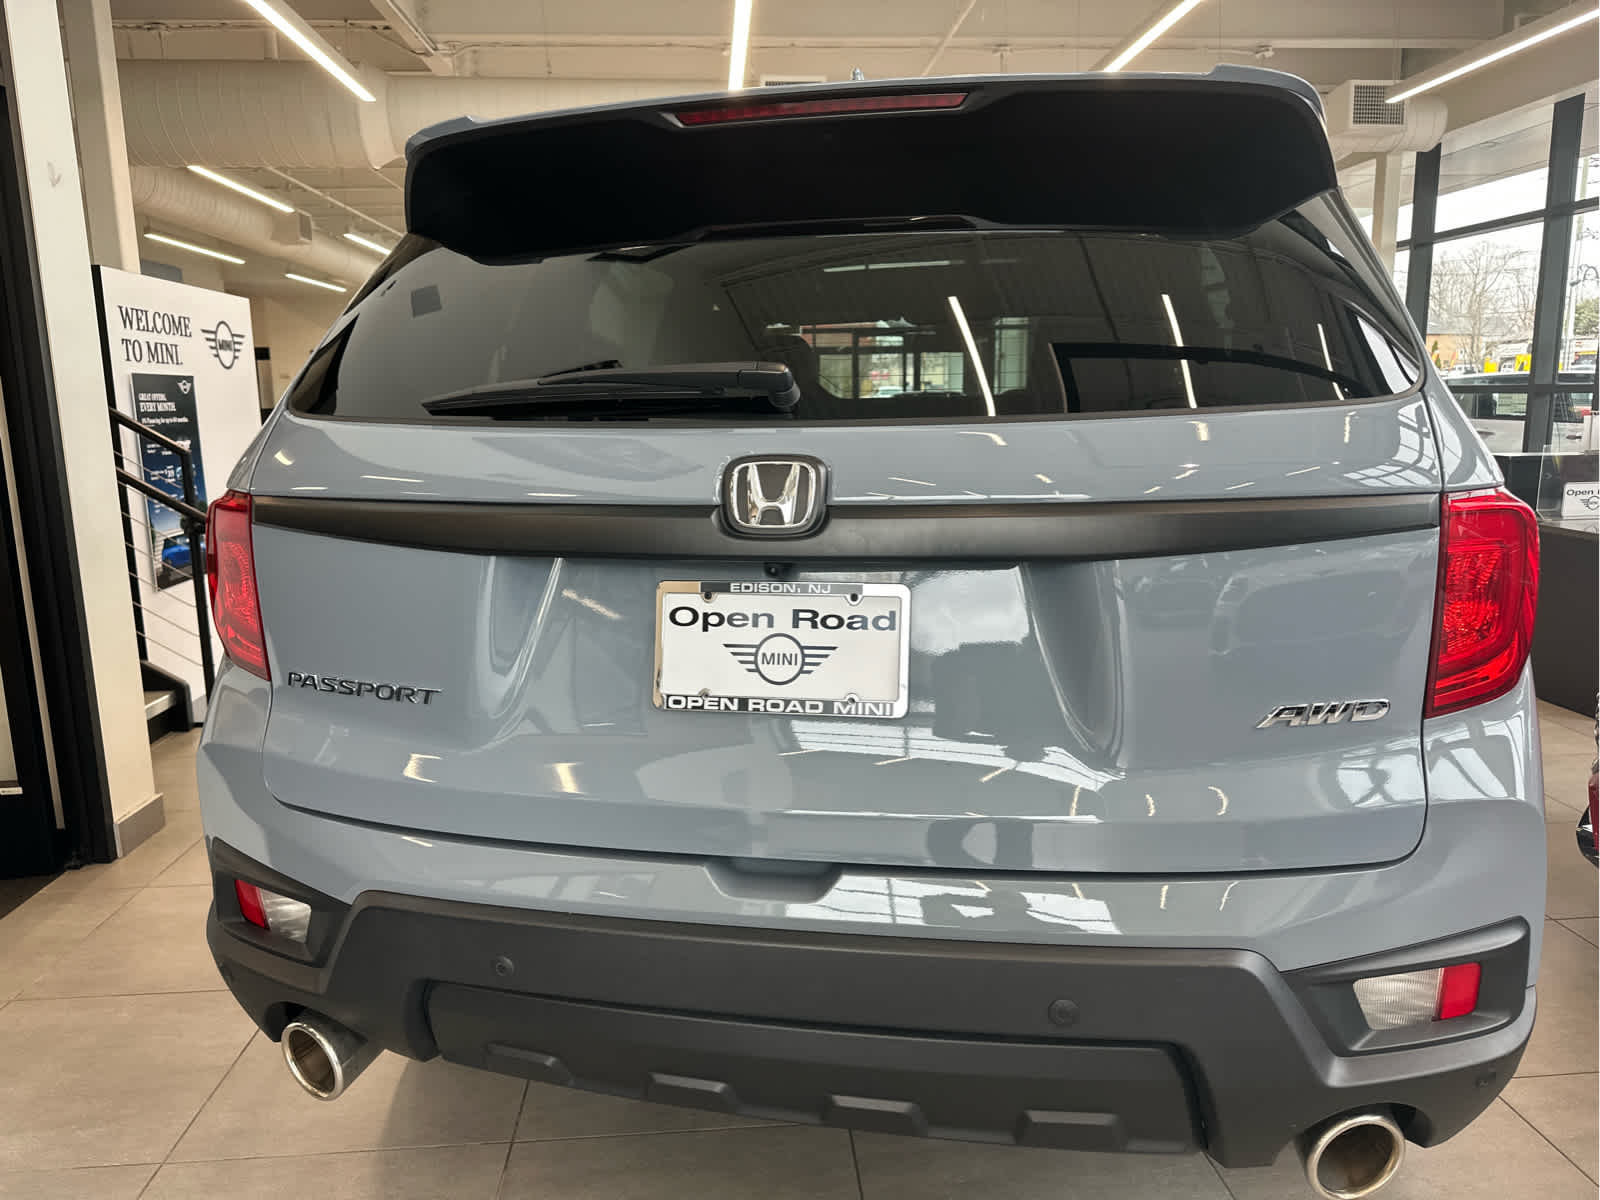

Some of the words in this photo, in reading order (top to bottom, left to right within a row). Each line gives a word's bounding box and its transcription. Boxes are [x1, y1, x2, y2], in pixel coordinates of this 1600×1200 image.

[118, 305, 192, 338] WELCOME
[121, 338, 142, 363] TO
[147, 341, 183, 366] MINI.
[1566, 489, 1593, 497] Open
[808, 583, 831, 594] NJ
[669, 606, 774, 632] Open
[792, 608, 896, 631] Road
[761, 652, 798, 666] MINI
[287, 671, 442, 704] PASSPORT
[667, 696, 739, 711] OPEN
[748, 698, 823, 714] ROAD
[833, 701, 892, 716] MINI
[1256, 699, 1390, 728] AWD
